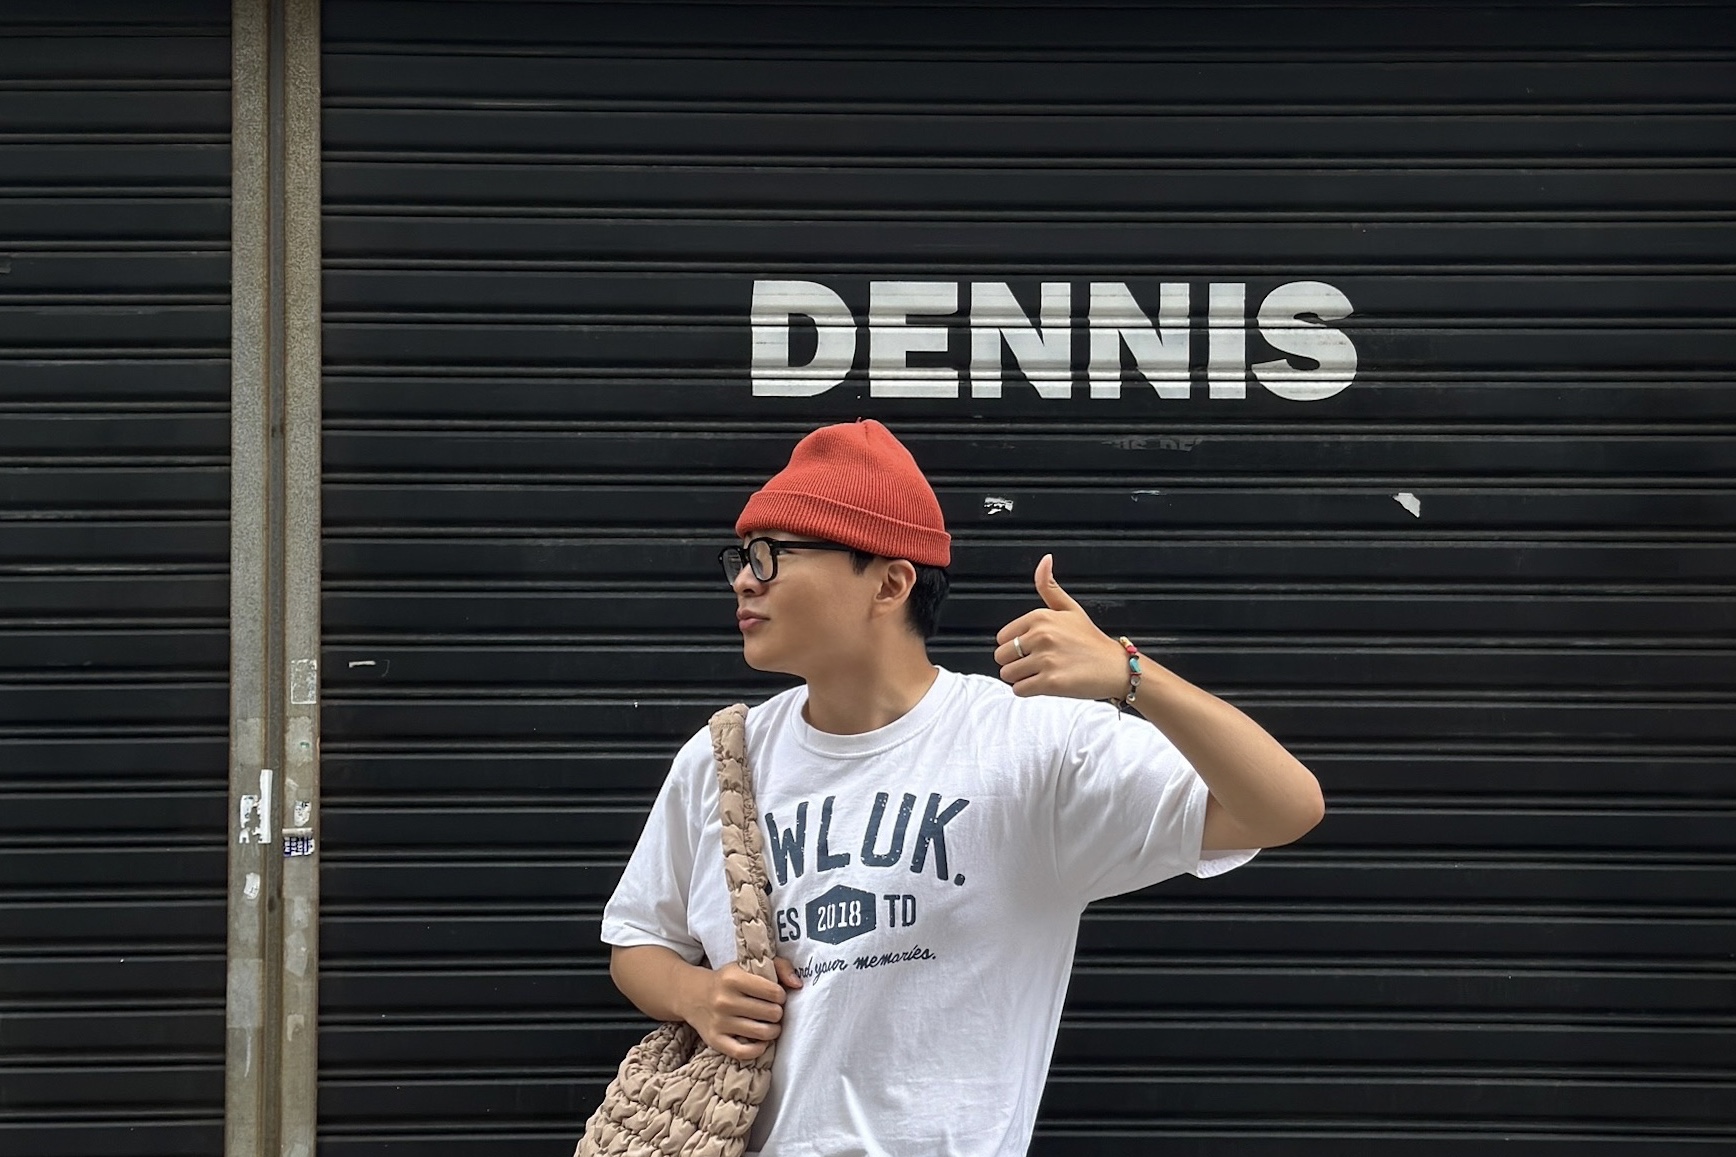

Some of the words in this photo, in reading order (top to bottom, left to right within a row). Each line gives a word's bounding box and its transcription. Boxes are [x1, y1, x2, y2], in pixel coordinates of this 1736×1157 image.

[751, 280, 1358, 401] DENNIS
[764, 791, 970, 890] WLUK.
[776, 906, 801, 943] ES
[817, 900, 862, 932] 2018
[883, 893, 917, 928] TD
[812, 958, 849, 987] your
